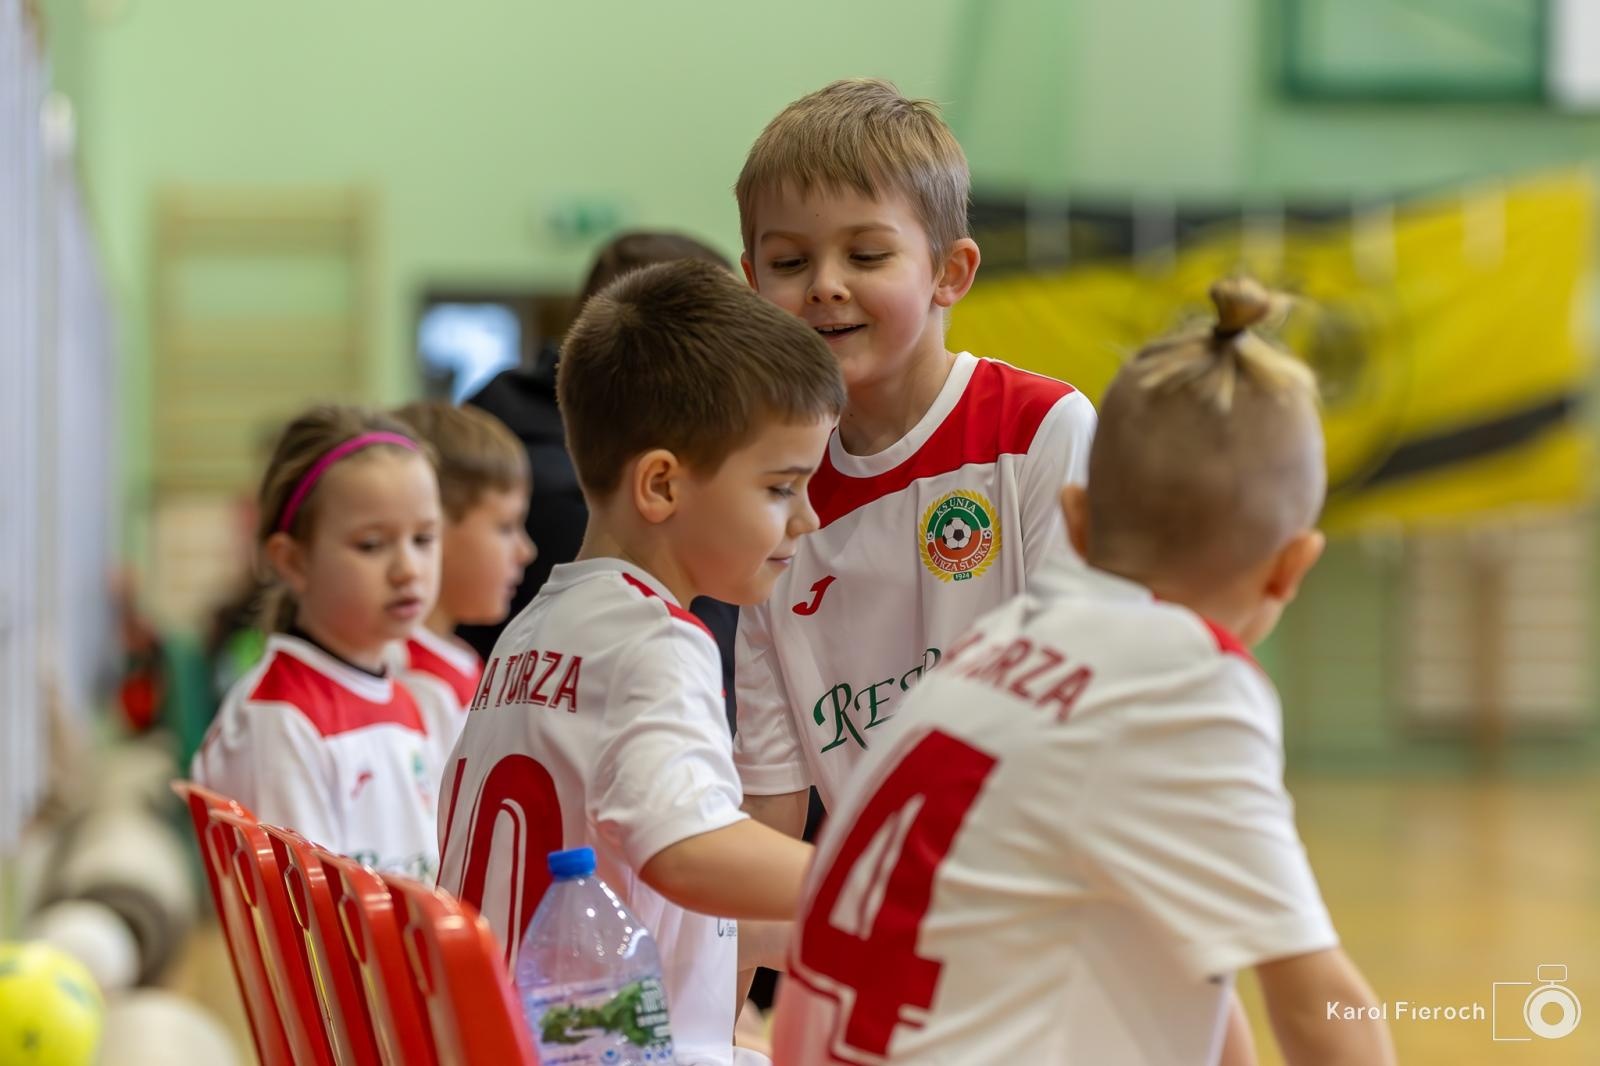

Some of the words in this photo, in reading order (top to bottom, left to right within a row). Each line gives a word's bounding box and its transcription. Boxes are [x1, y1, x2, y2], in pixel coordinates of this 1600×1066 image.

[949, 498, 976, 513] UNIA
[931, 551, 958, 571] TURZA
[495, 649, 583, 714] TURZA
[786, 727, 1002, 1066] 4
